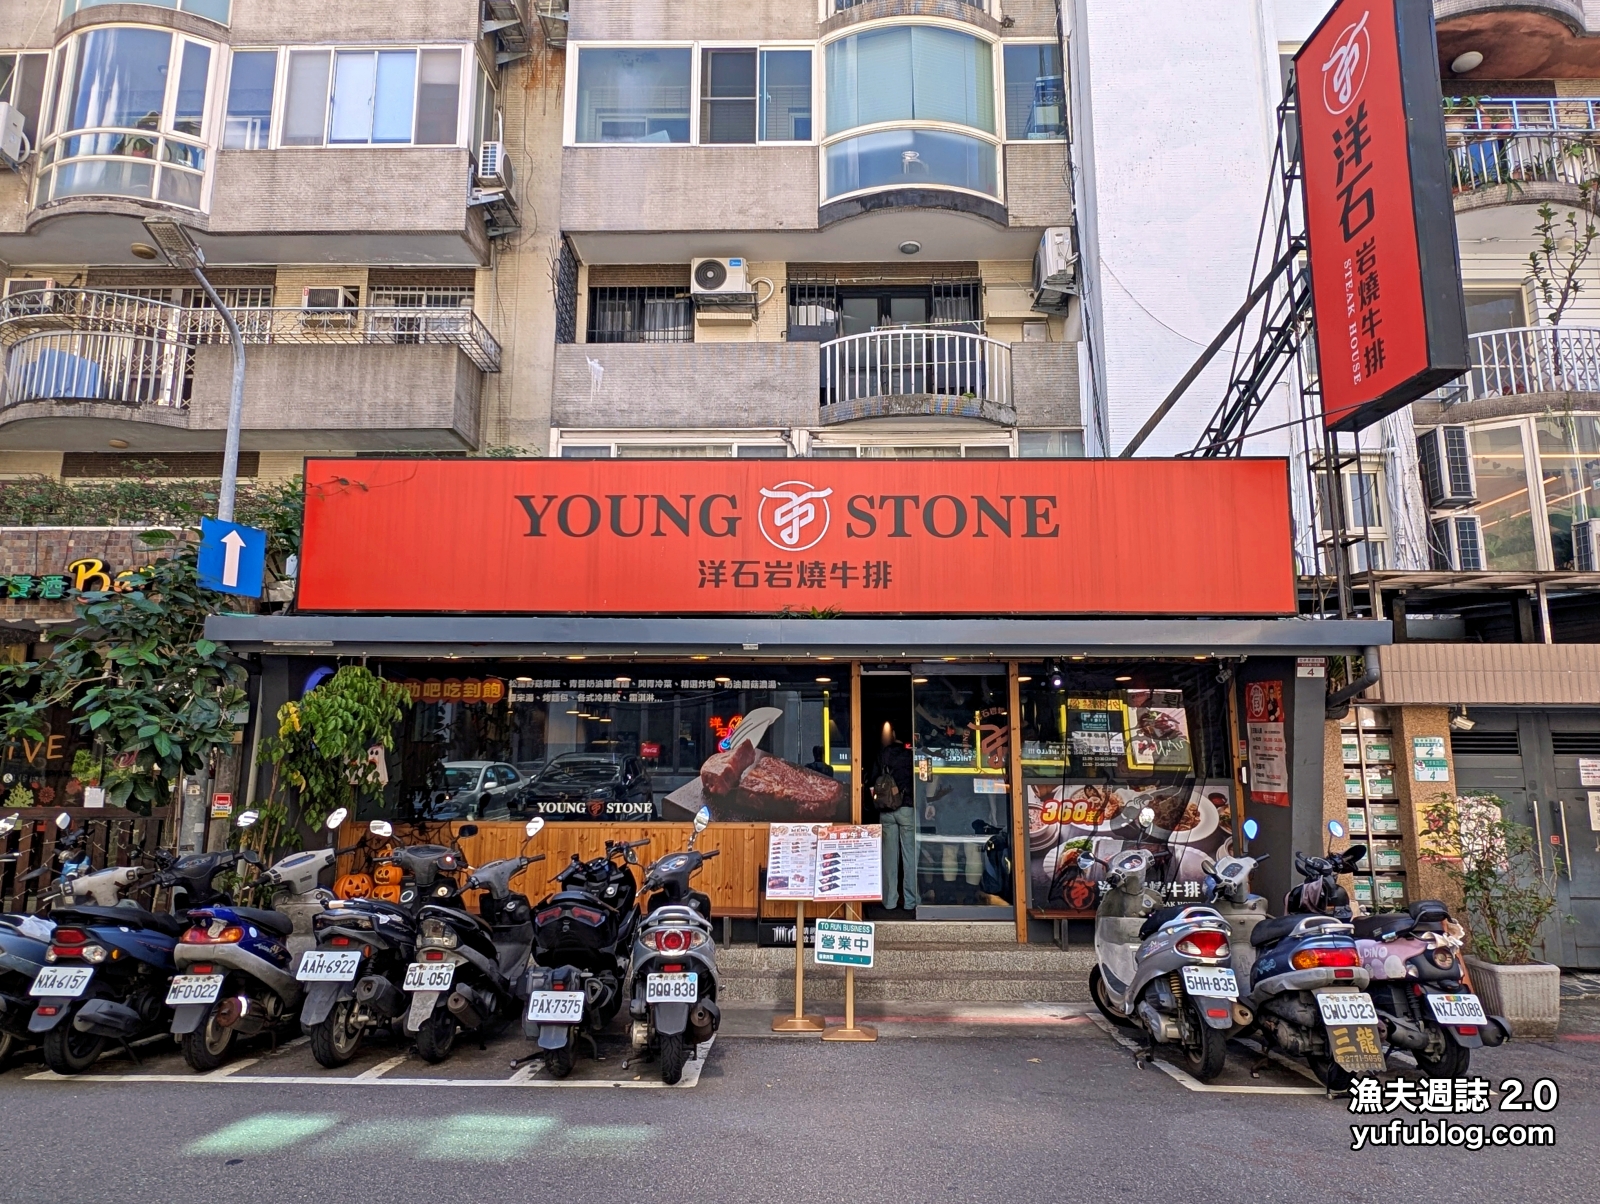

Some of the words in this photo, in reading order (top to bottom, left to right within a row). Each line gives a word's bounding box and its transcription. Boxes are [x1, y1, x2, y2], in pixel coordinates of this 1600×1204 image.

[1333, 99, 1374, 244] 洋石
[1344, 258, 1356, 318] STEAK
[1356, 236, 1386, 379] 岩燒牛排
[1349, 322, 1362, 385] HOUSE
[514, 494, 742, 539] YOUNG
[846, 494, 1060, 539] STONE
[697, 560, 893, 589] 洋石岩燒牛排
[1307, 668, 1315, 676] 4
[402, 682, 501, 698] 助吧吃到飽
[8, 735, 66, 764] IVE
[1426, 748, 1434, 757] 4
[1429, 771, 1436, 780] 4
[537, 802, 586, 814] YOUNG
[606, 802, 653, 814] STONE
[821, 934, 869, 952] 營業中
[843, 925, 870, 933] BUSINESS
[1333, 1026, 1379, 1055] 三龍
